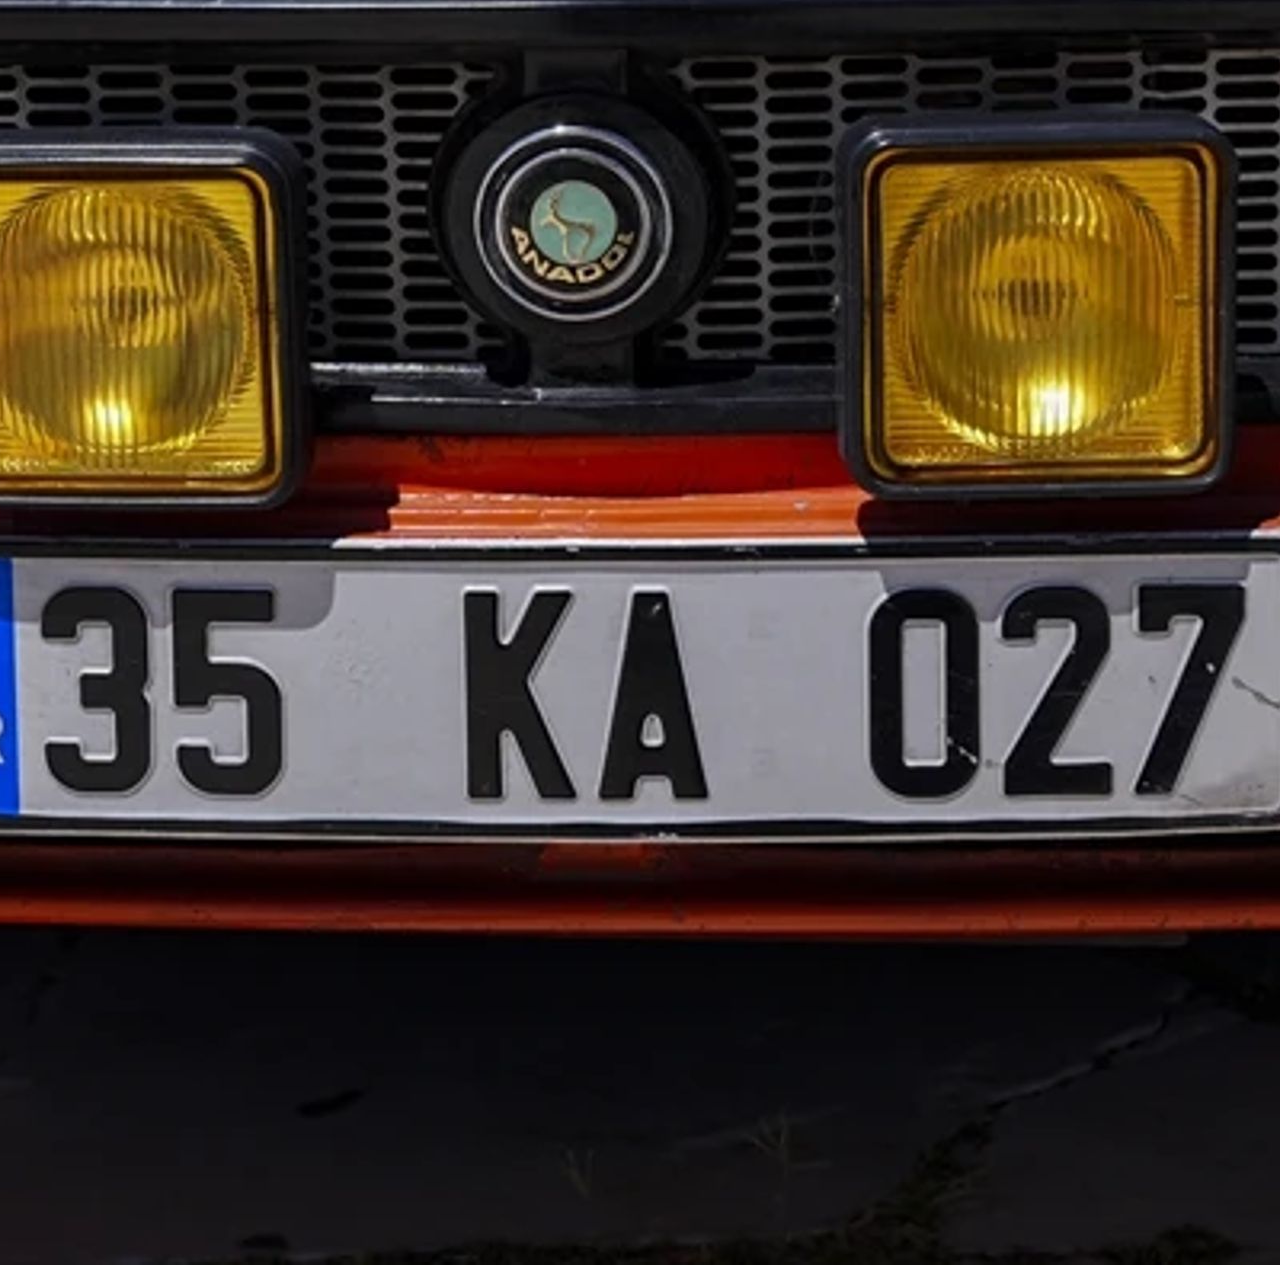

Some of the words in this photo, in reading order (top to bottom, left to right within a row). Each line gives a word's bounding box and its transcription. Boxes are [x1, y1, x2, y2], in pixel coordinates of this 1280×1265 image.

[511, 226, 635, 284] ANADOL
[40, 585, 284, 797] 35
[461, 589, 709, 801] KA
[867, 584, 1247, 800] 027
